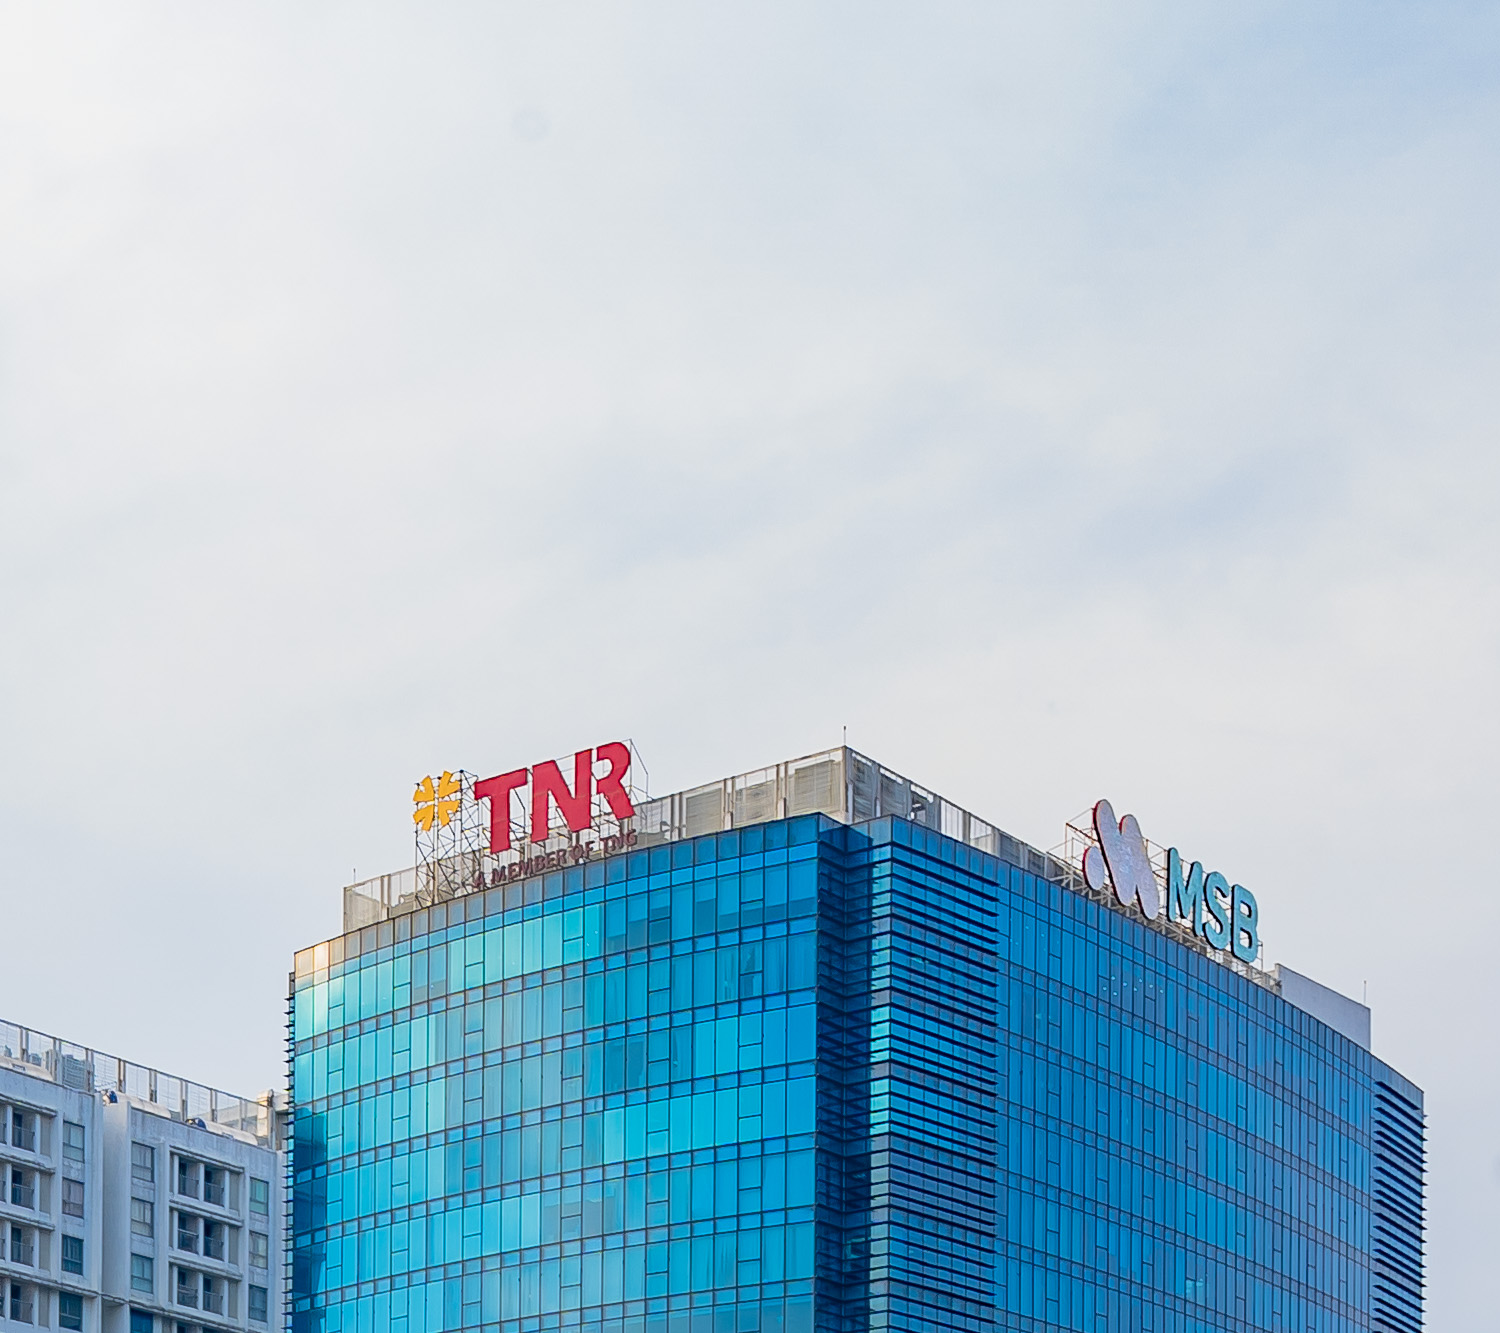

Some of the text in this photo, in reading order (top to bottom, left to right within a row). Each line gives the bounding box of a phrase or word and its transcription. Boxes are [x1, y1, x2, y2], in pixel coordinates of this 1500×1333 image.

[474, 742, 635, 854] TNR
[491, 851, 563, 884] MEMBER
[1167, 847, 1258, 963] MSB
